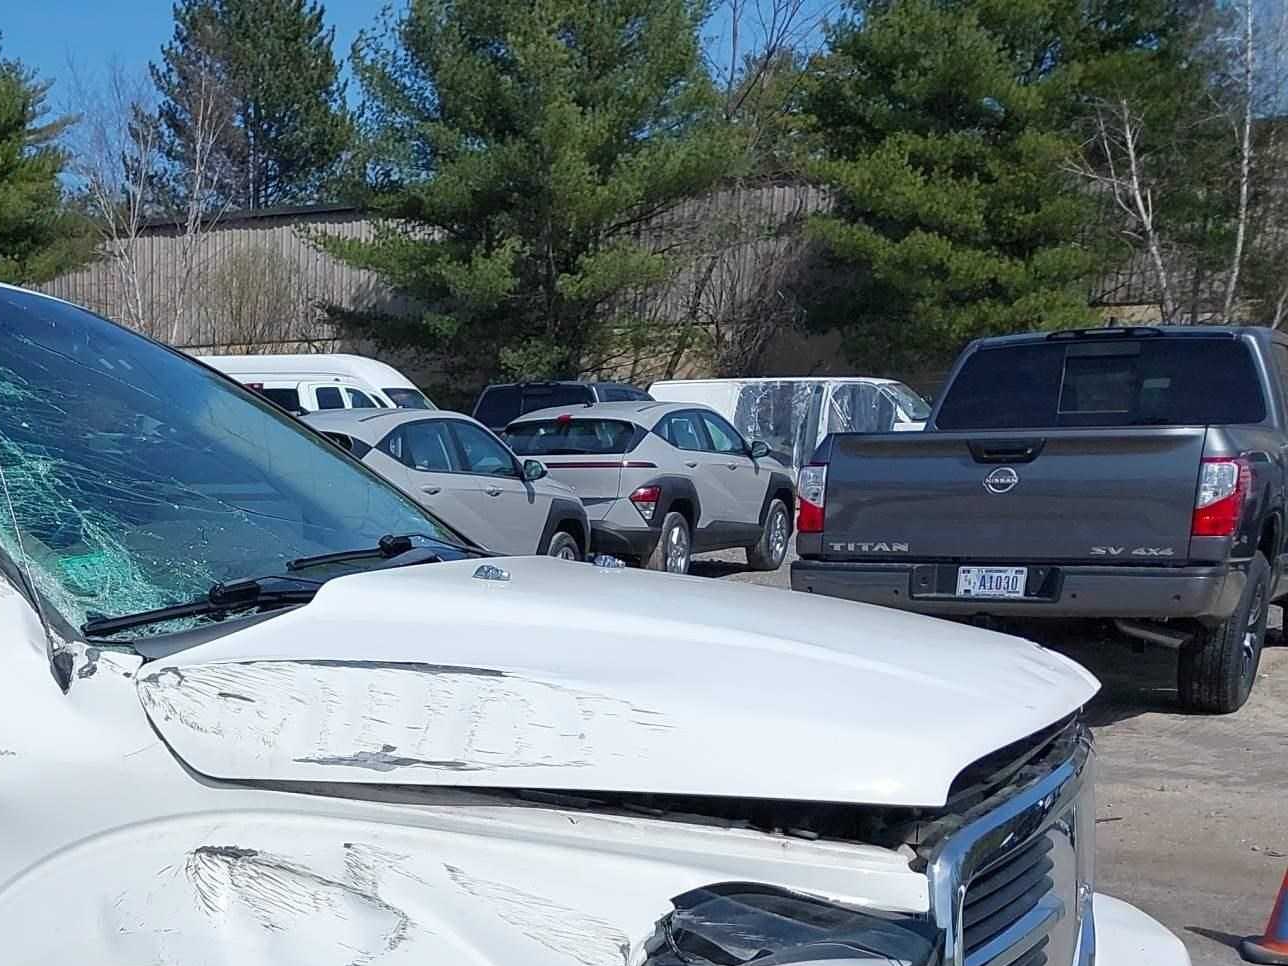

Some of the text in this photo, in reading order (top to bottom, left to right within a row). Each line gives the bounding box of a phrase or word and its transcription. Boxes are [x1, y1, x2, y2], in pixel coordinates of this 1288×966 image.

[828, 542, 910, 553] TITAN
[1089, 545, 1125, 555] SV
[978, 575, 1019, 591] A1030
